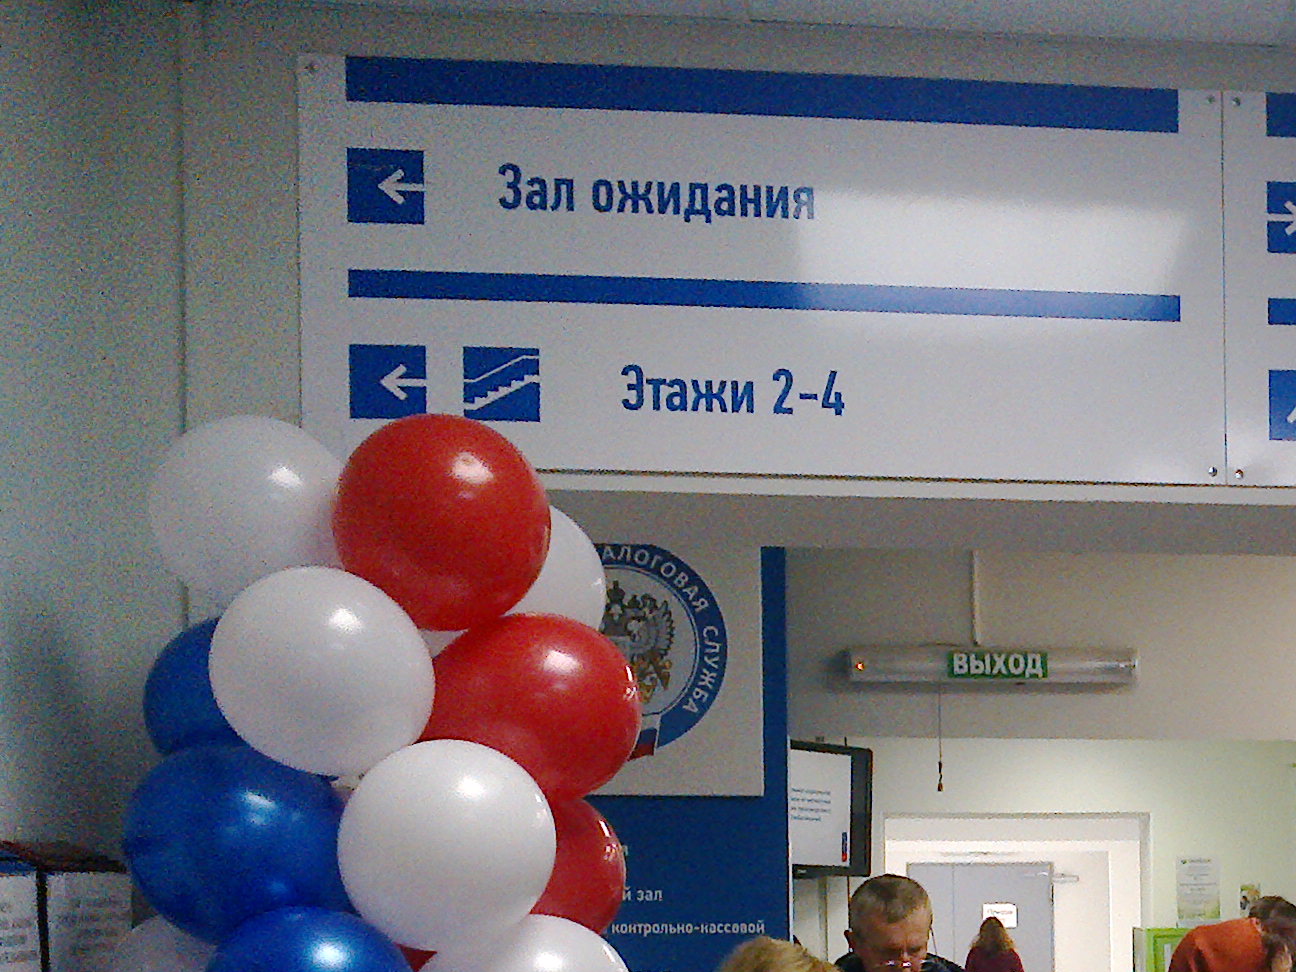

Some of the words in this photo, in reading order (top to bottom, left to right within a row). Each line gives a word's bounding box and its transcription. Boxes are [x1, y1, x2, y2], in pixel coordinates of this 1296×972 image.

[497, 164, 577, 212] Зал
[591, 178, 816, 222] ожидания
[621, 364, 755, 414] Этажи
[771, 369, 845, 414] 2-4
[602, 545, 709, 612] АЛОГОВАЯ
[682, 625, 721, 713] СЛУЖБА
[952, 651, 1045, 678] ВЫХОД
[636, 887, 663, 902] зал
[611, 919, 766, 937] контрольно-кассовой
